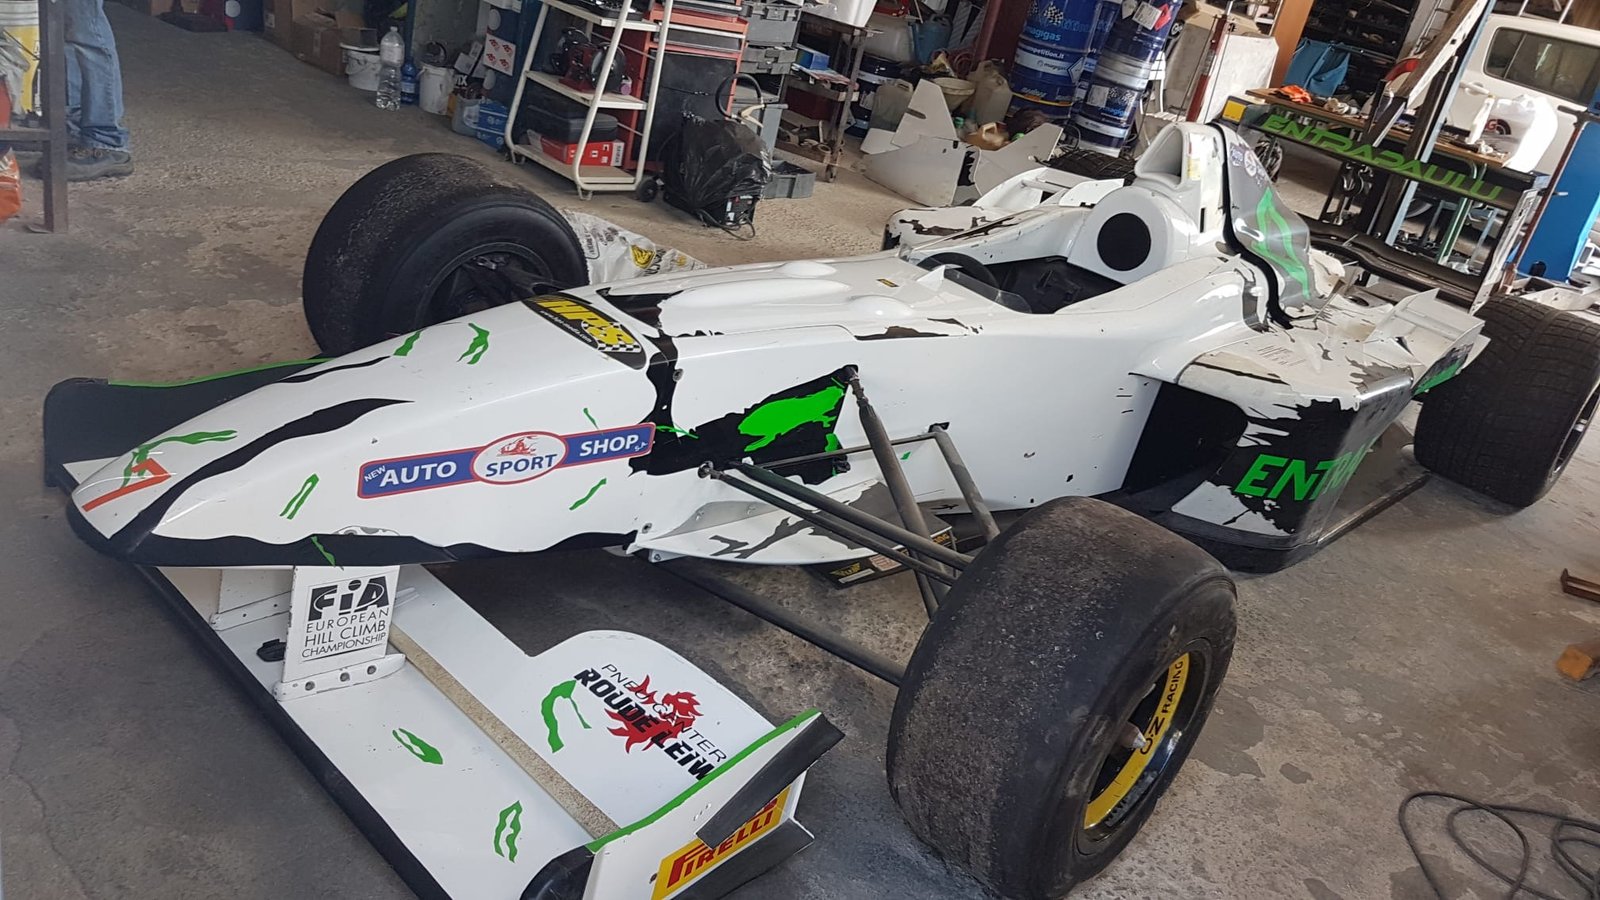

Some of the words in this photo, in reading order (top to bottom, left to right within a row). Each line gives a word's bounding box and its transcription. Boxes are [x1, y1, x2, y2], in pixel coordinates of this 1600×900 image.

[580, 435, 639, 457] SHOP
[364, 465, 386, 481] NEW
[380, 461, 456, 486] AUTO
[486, 454, 557, 477] SPORT
[307, 608, 389, 633] EUROPEAN
[302, 633, 386, 658] CHAMPIONSHIP
[305, 633, 333, 647] HILL
[341, 622, 385, 639] CLIMB
[1162, 661, 1183, 714] RACING
